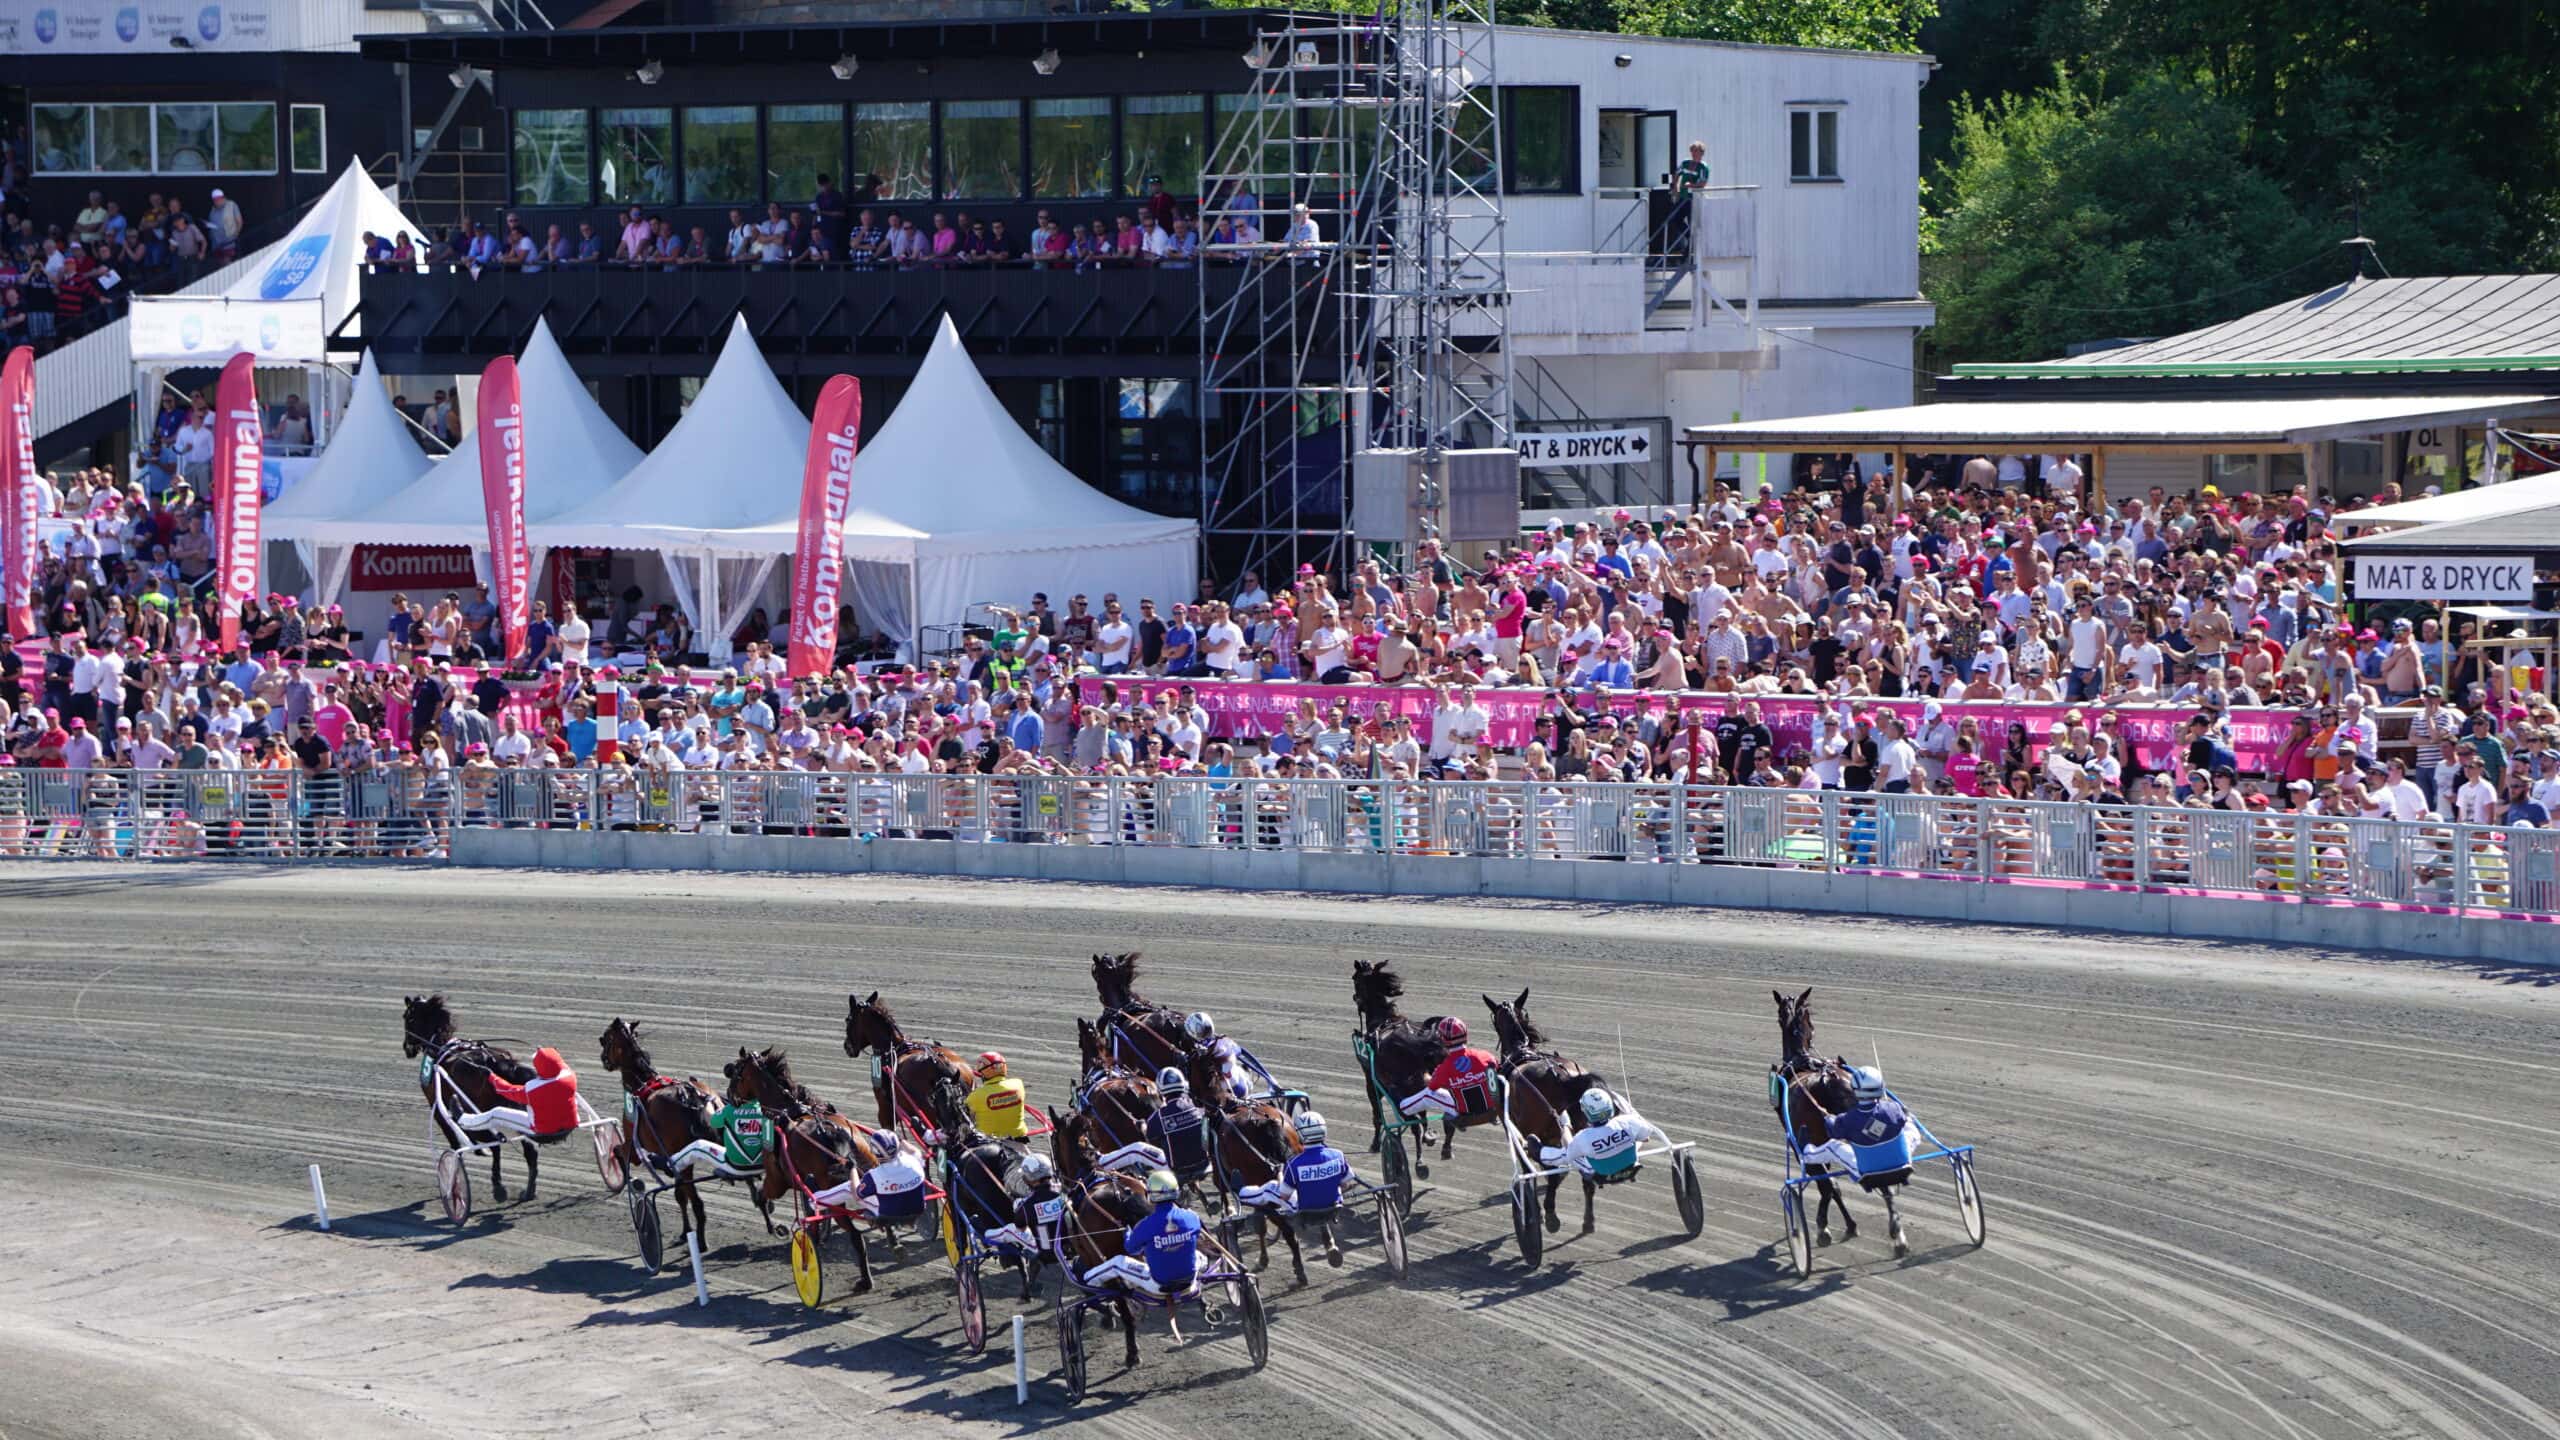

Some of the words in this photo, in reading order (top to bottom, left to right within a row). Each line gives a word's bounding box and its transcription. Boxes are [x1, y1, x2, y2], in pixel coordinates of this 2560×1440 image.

[1514, 440, 1541, 459] AT
[1547, 440, 1560, 458] &
[1567, 436, 1626, 457] DRYCK
[2367, 565, 2416, 590] MAT
[2421, 566, 2437, 590] &
[2443, 566, 2524, 591] DRYCK
[1487, 1067, 1497, 1093] 8
[1591, 1129, 1630, 1152] SVEA
